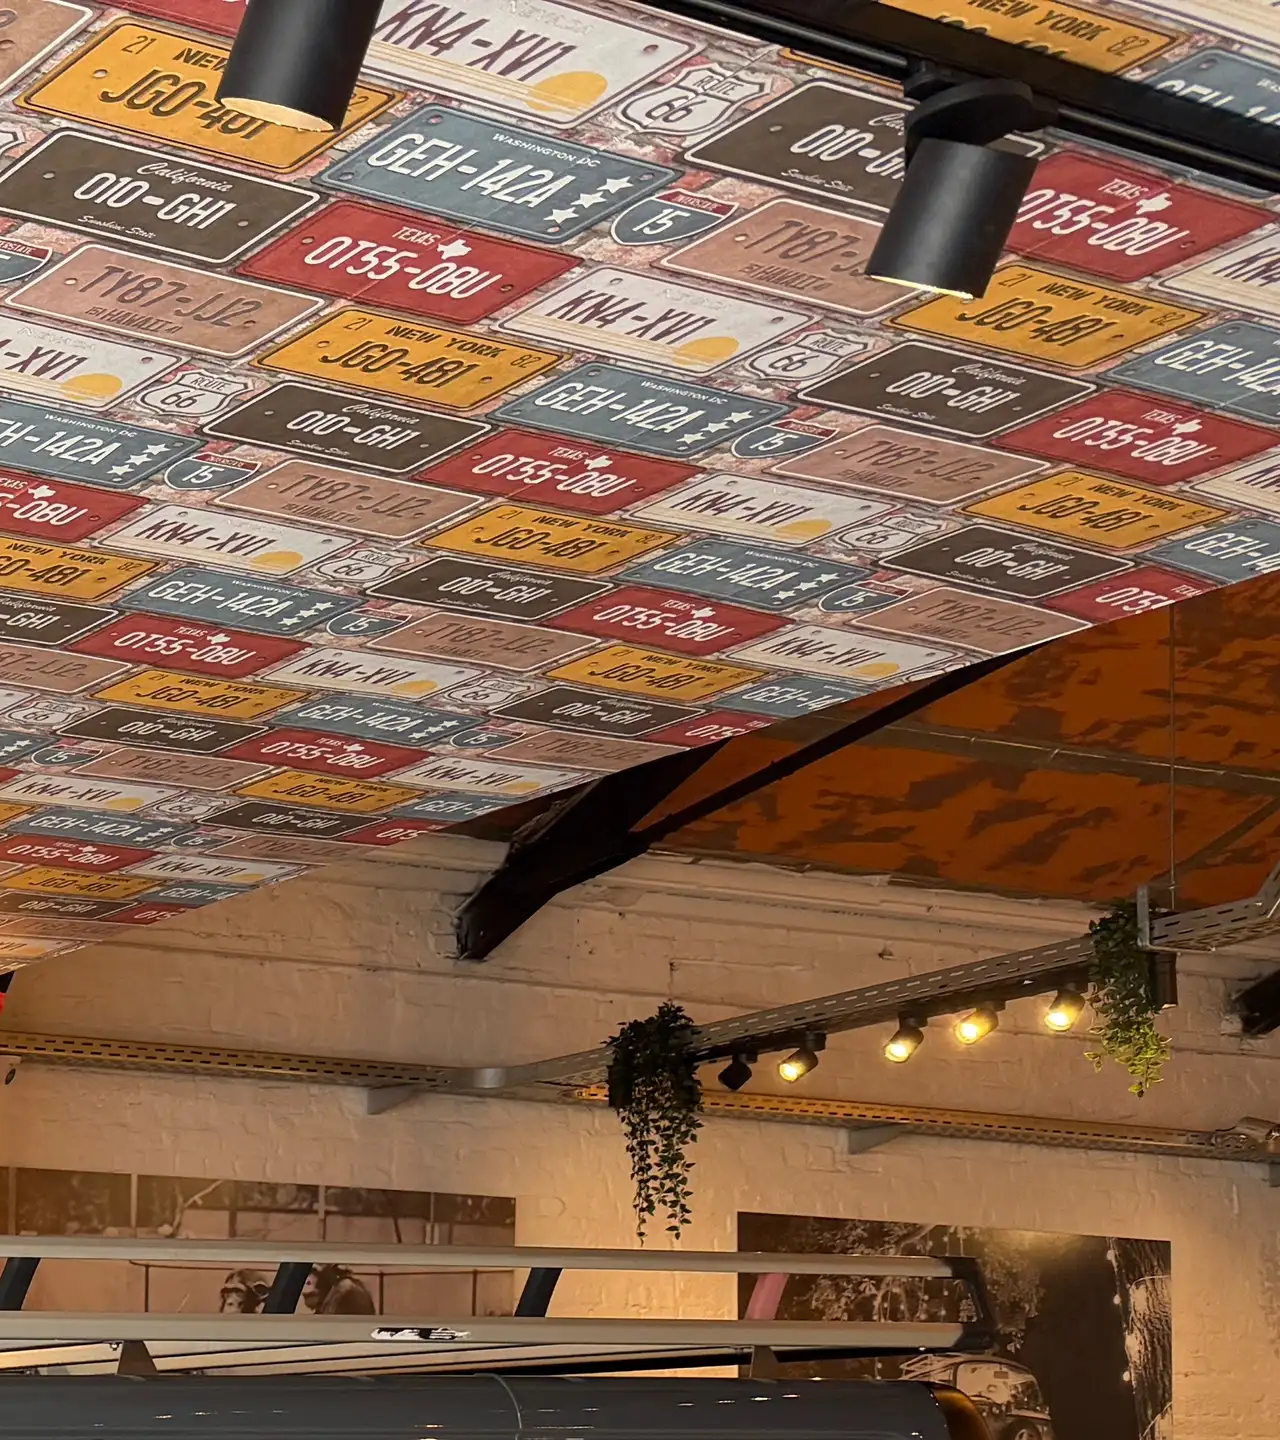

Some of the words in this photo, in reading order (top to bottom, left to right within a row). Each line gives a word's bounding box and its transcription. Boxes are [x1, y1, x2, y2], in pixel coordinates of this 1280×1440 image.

[492, 132, 576, 161] WASHINGTON
[575, 156, 600, 167] DC
[136, 163, 233, 193] California
[368, 134, 573, 208] GEH-142A
[391, 226, 441, 246] TEXAS
[536, 381, 704, 433] GEH-142A
